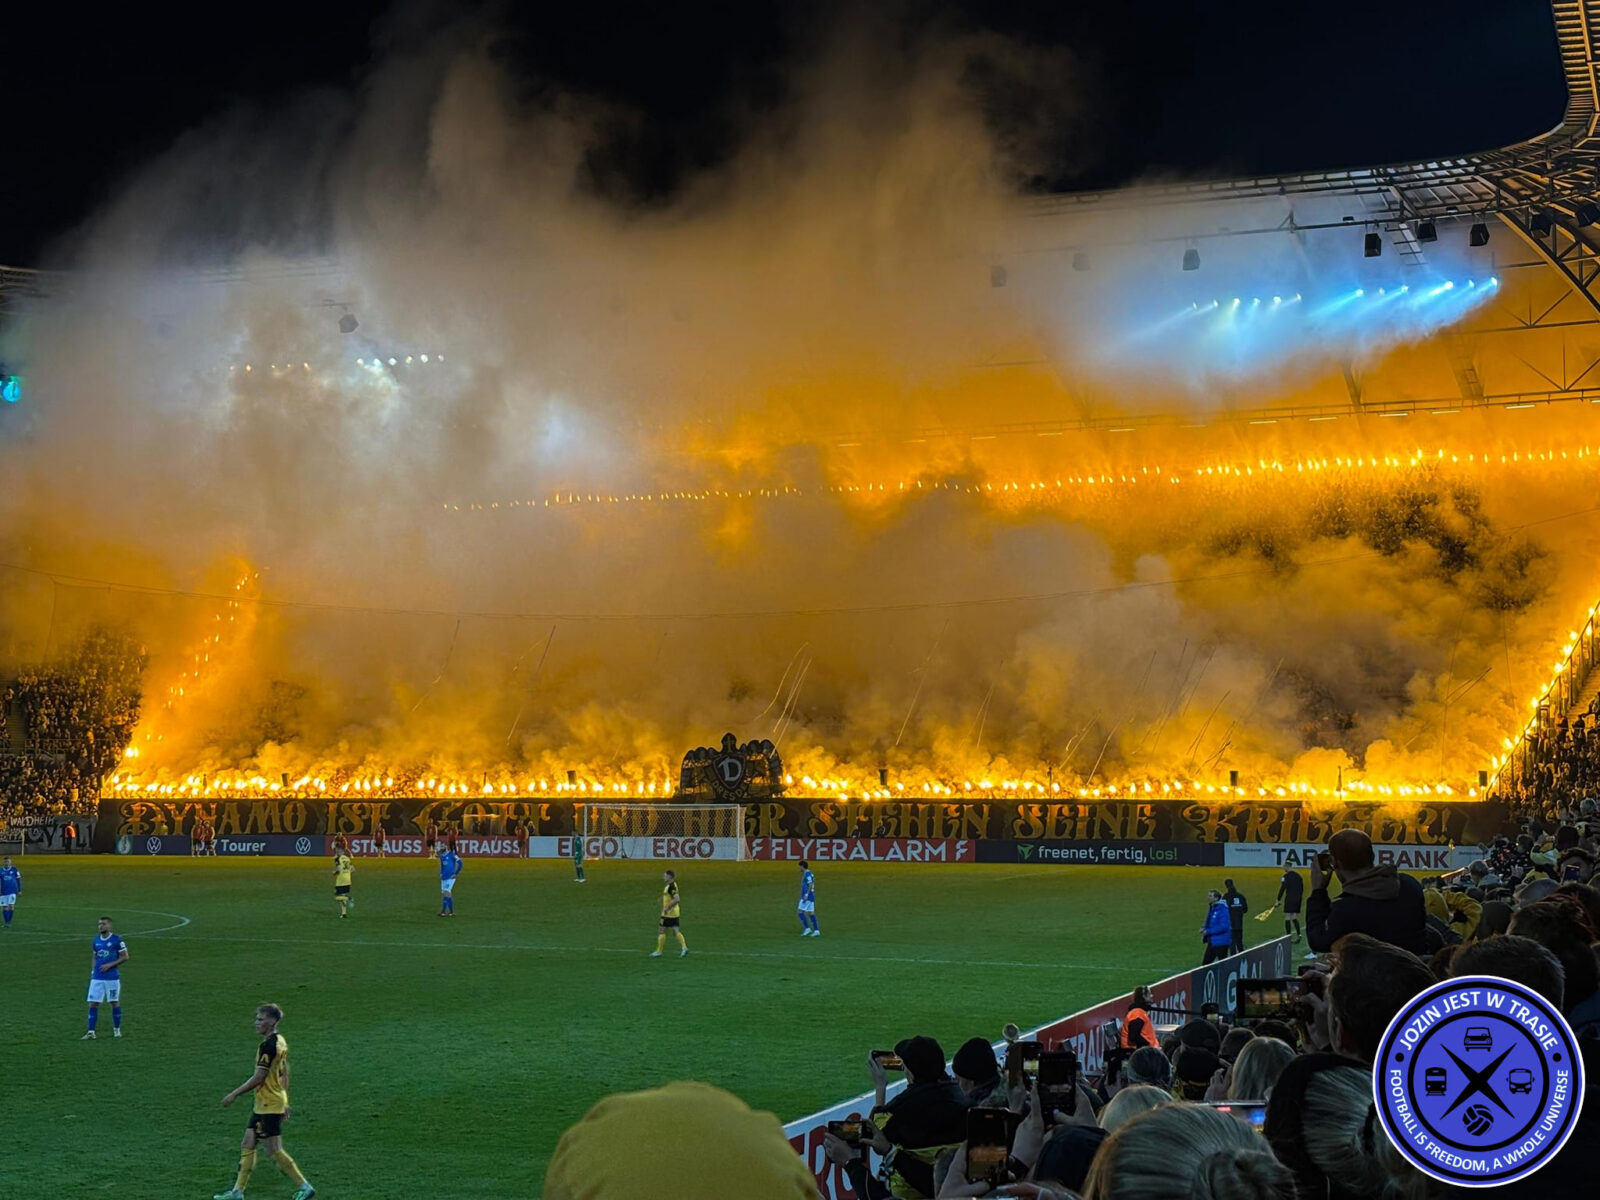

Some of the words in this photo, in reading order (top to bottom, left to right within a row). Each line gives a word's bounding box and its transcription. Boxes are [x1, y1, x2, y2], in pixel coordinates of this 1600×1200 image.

[326, 801, 392, 836] IST
[808, 802, 990, 840] STEHEN
[1013, 803, 1157, 841] SEINE
[221, 839, 266, 852] Tourer
[455, 839, 520, 855] TRAUSS
[557, 838, 619, 858] EGO
[652, 838, 715, 858] ERGO
[771, 838, 947, 862] FLYERALARM
[1038, 845, 1099, 863] freenet,
[1100, 846, 1148, 863] fertig,
[1149, 847, 1178, 861] los!
